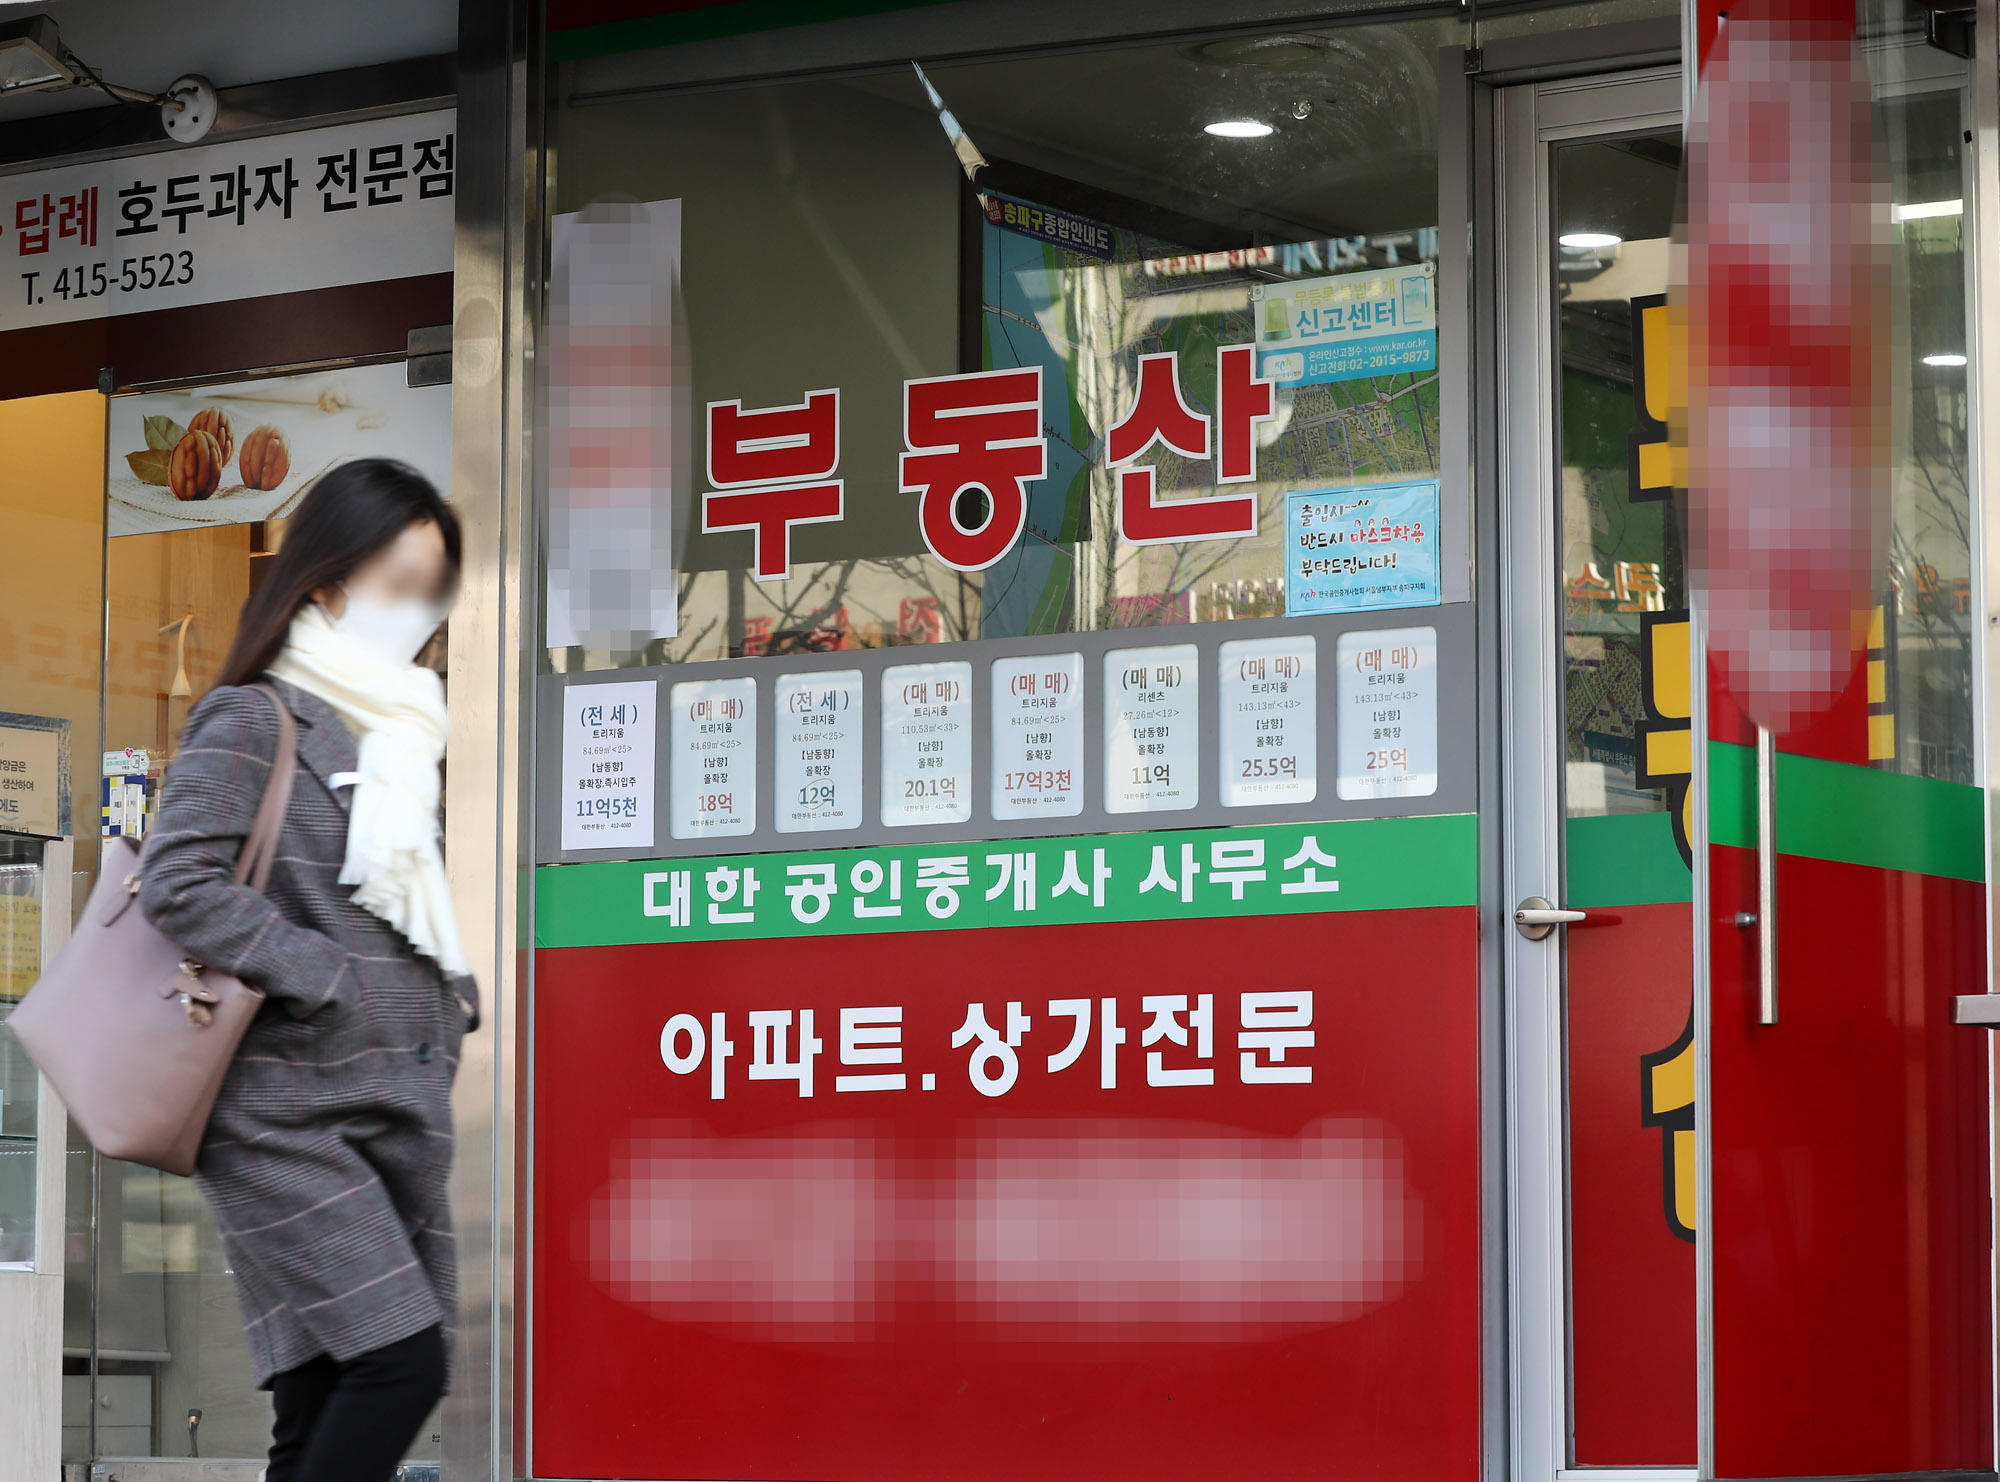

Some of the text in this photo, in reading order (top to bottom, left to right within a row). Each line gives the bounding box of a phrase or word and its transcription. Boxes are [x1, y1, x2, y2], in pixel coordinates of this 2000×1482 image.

[15, 134, 455, 256] 답례 호두과자 전문점
[21, 250, 194, 306] T. 415-5523
[1295, 286, 1336, 307] 무등록
[1296, 298, 1396, 338] 신고센터
[1308, 346, 1362, 361] 온라인신고접수
[1369, 338, 1427, 354] www.kar.or.kr
[702, 343, 1275, 582] 부동산
[1300, 523, 1424, 550] 반드시 마스크착용
[1301, 553, 1397, 578] 부탁드립니다!
[1251, 682, 1288, 694] 트리지움
[1368, 673, 1405, 685] 트리지움
[1021, 697, 1057, 708] 트리지움
[1138, 691, 1165, 703] 리센츠
[801, 714, 836, 725] 트리지움
[913, 705, 948, 717] 트리지움
[592, 728, 624, 739] 트리지움
[700, 722, 733, 733] 트리지움
[1373, 727, 1401, 739] 올확장
[1138, 744, 1165, 755] 올확장
[1256, 735, 1283, 747] 올확장
[918, 757, 944, 768] 올확장
[1025, 749, 1052, 760] 올확장
[1367, 748, 1406, 771] 25억
[805, 765, 831, 776] 올확장
[1132, 764, 1169, 786] 11억
[1242, 756, 1296, 778] 25.5억
[2, 778, 34, 791] 생산하여
[704, 773, 728, 784] 올확장
[904, 777, 955, 798] 20.1억
[1004, 769, 1071, 792] 17억3천
[698, 793, 732, 814] 18억
[800, 785, 834, 807] 12억
[576, 797, 637, 819] 11억5천
[643, 835, 1341, 929] 대한 공인중개사 사무소
